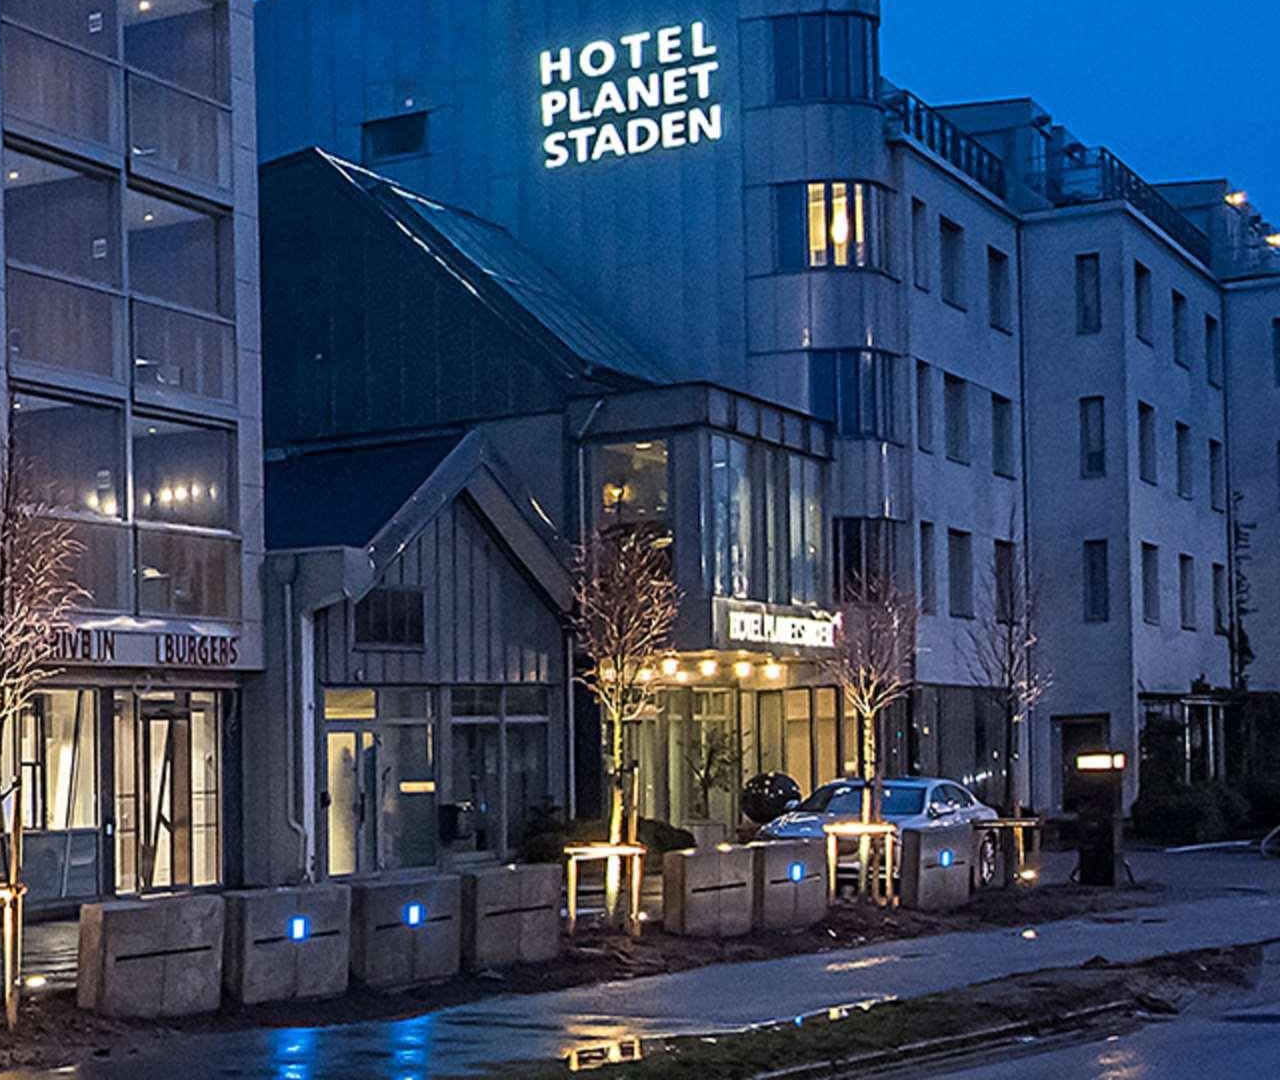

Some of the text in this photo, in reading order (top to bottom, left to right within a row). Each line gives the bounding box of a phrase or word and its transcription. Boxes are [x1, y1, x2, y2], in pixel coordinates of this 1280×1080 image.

[540, 20, 717, 86] HOTEL
[541, 61, 719, 127] PLANET
[543, 104, 722, 169] STADEN
[39, 627, 92, 660] RIVE
[164, 633, 238, 666] BURGERS
